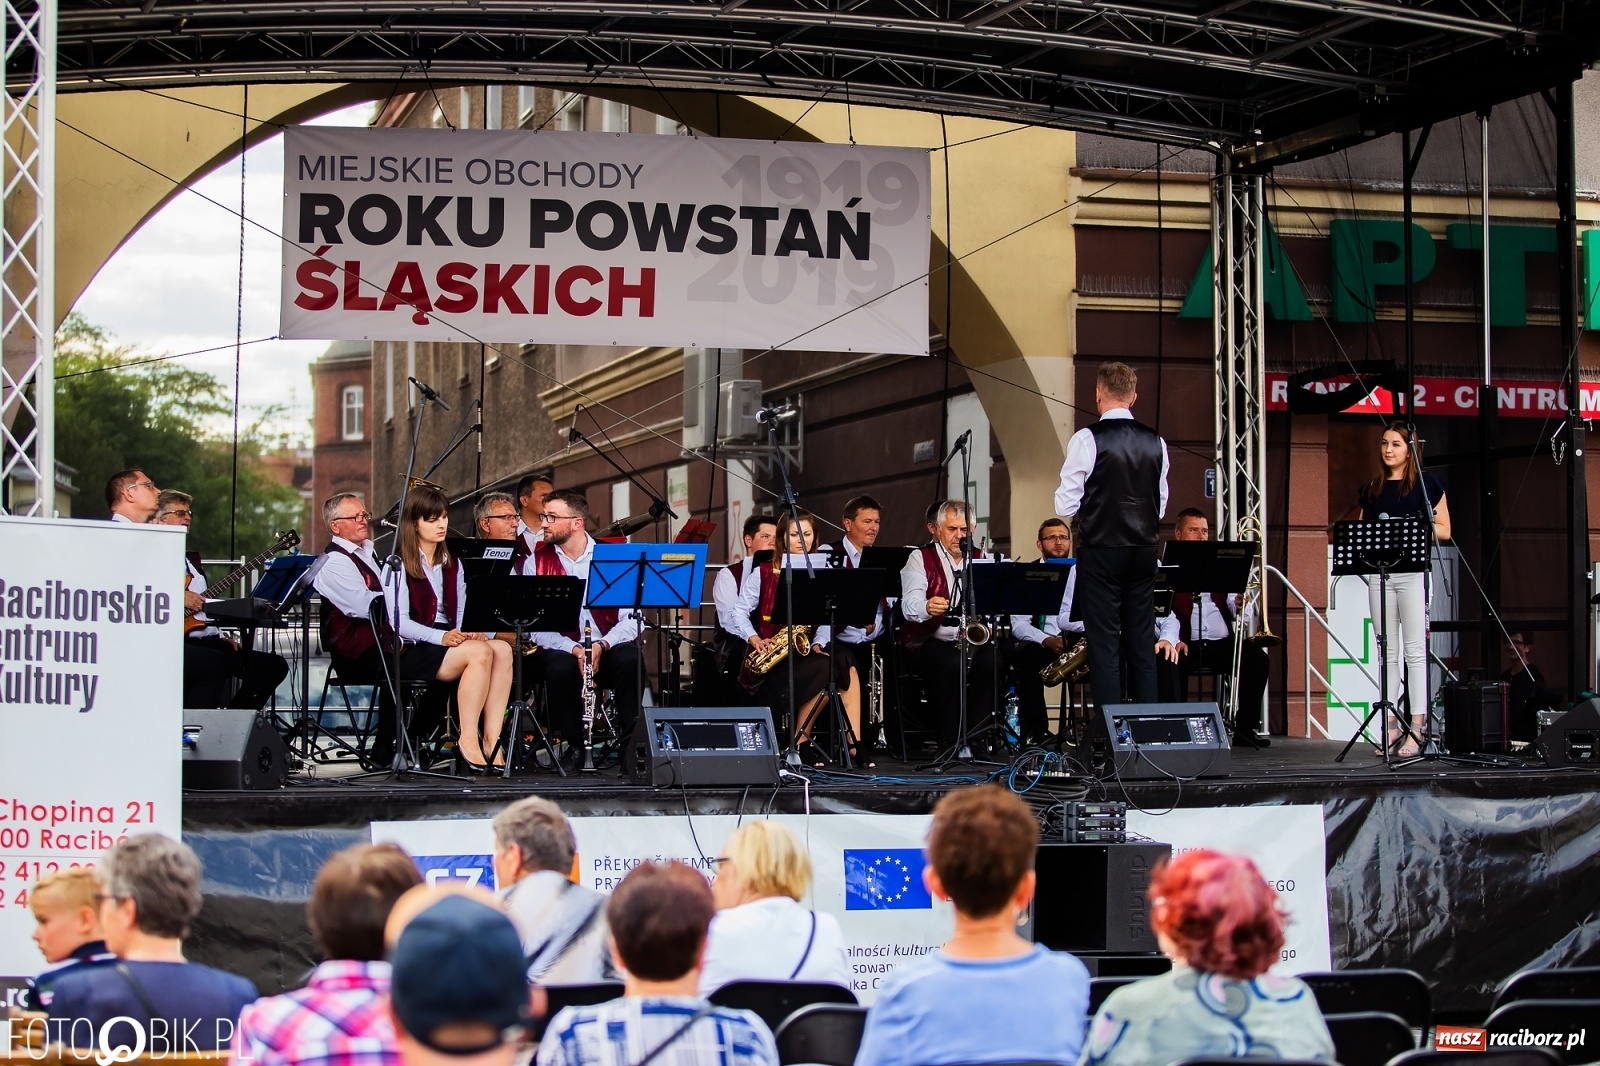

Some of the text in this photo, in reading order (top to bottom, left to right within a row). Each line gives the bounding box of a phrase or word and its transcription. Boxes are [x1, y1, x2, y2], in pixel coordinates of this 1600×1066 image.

[298, 154, 644, 189] MIEJSKIE OBCHODY
[721, 154, 921, 227] 1919
[297, 192, 872, 261] ROKU POWSTAŃ
[293, 245, 657, 326] ŚLĄSKICH
[1178, 217, 1600, 331] APT
[485, 549, 512, 558] Tenor
[0, 623, 98, 664] ntrum
[0, 663, 99, 713] ultury
[125, 801, 155, 823] 21
